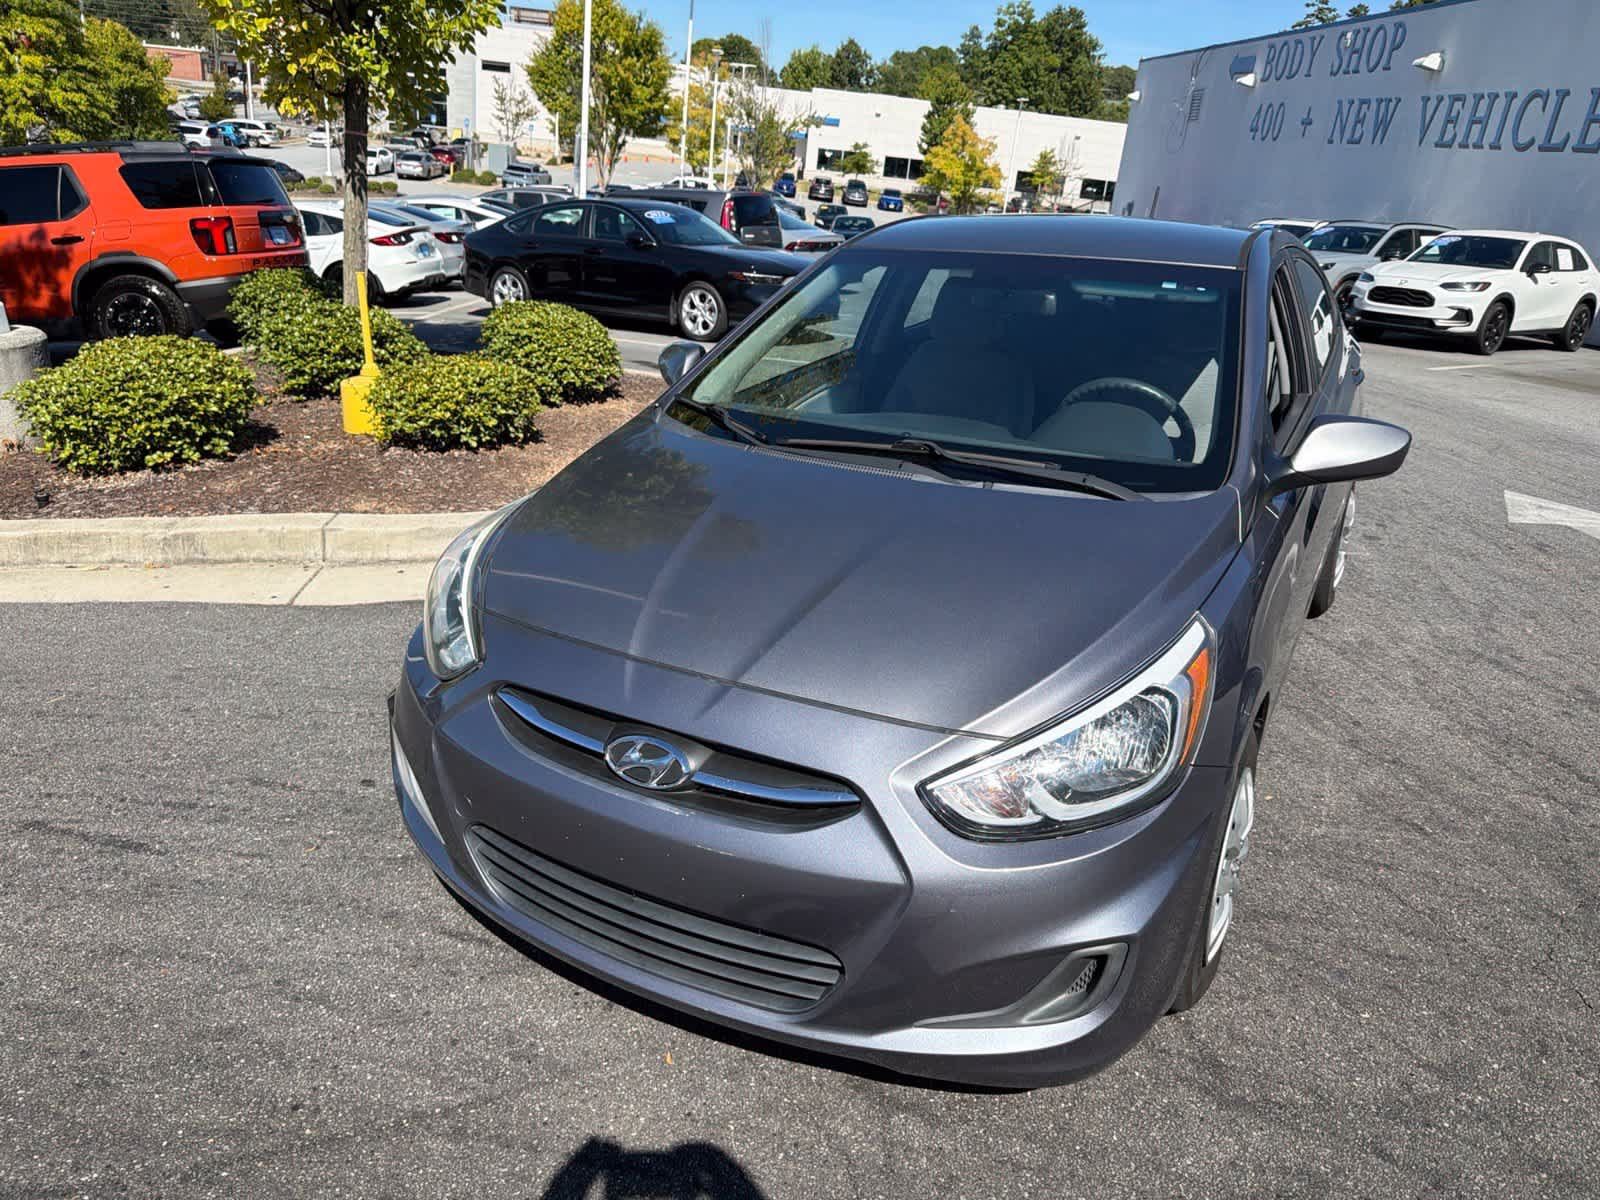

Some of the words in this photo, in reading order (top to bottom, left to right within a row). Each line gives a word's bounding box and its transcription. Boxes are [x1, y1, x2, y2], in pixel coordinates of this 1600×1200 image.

[1260, 34, 1325, 82] BODY
[1329, 21, 1407, 77] SHOP
[1249, 101, 1285, 142] 400
[1301, 105, 1313, 139] +
[1327, 96, 1402, 145] NEW
